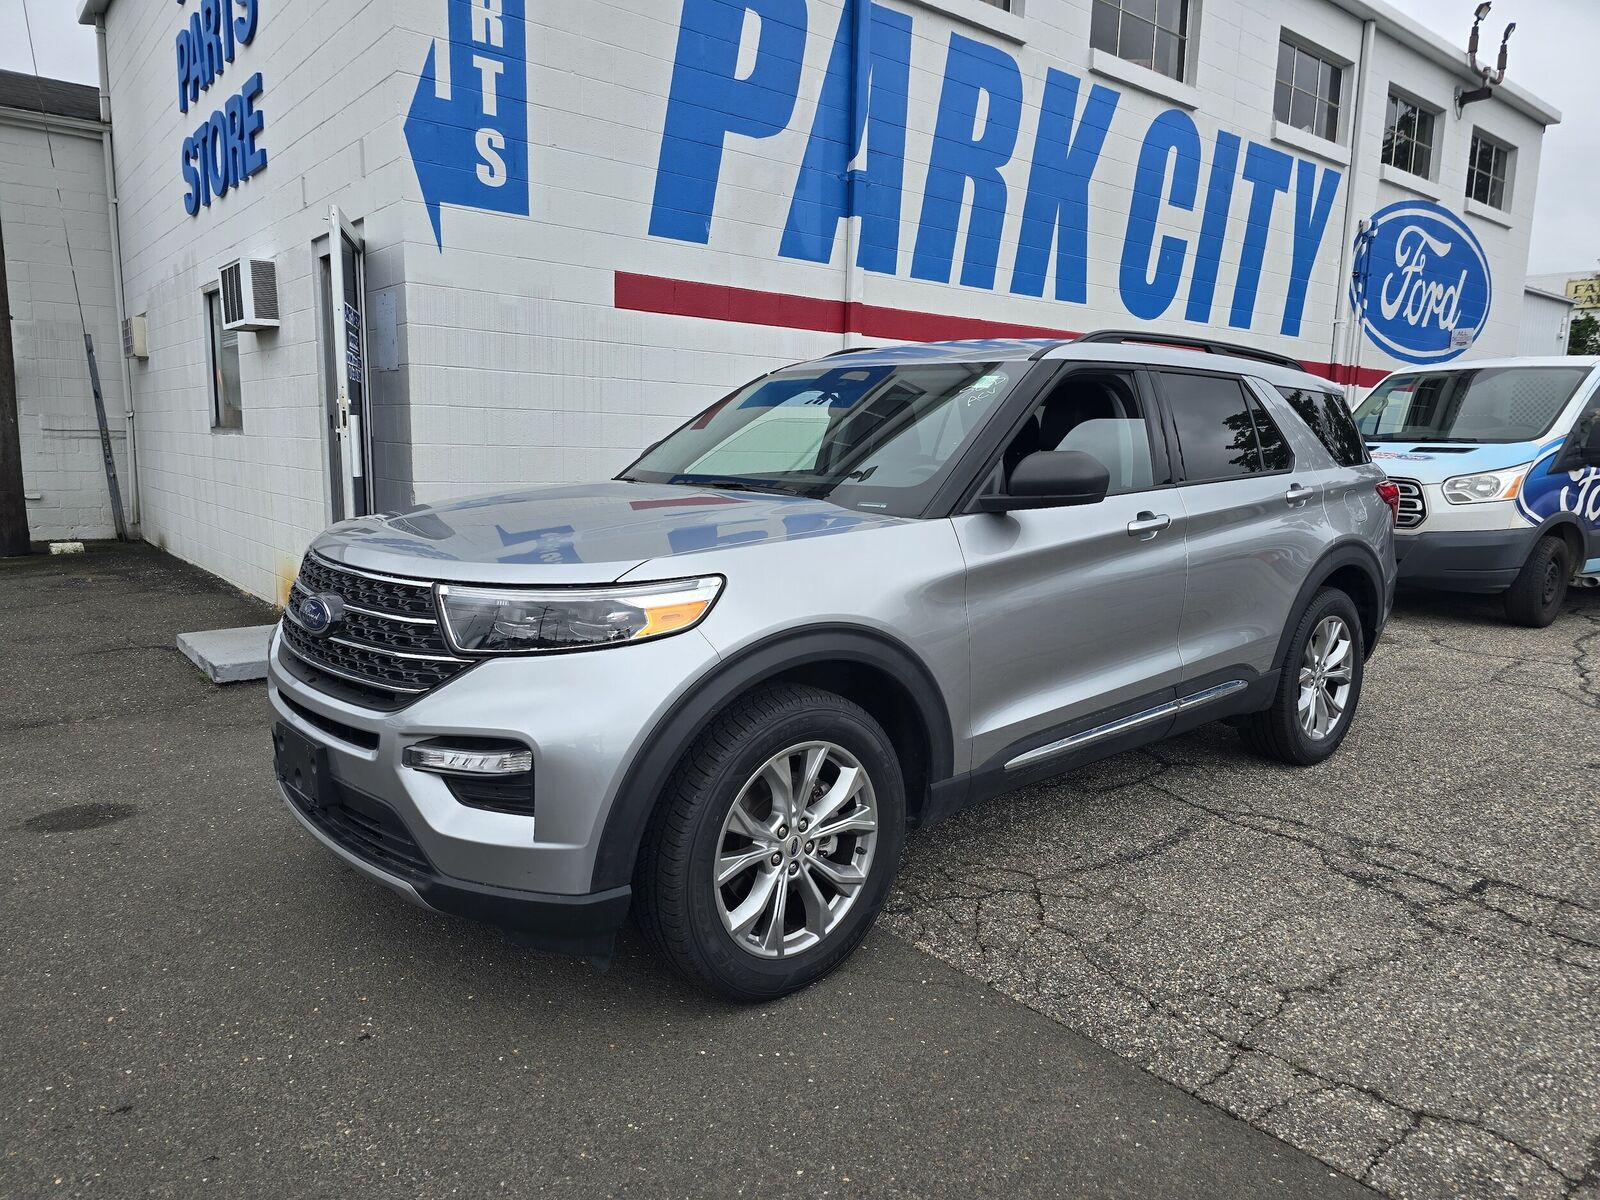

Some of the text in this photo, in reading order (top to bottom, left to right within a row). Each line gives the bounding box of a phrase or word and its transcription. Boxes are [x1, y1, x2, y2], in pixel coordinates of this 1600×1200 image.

[181, 72, 267, 217] STORE
[647, 0, 1342, 337] PARK CITY
[1380, 225, 1468, 331] Ford
